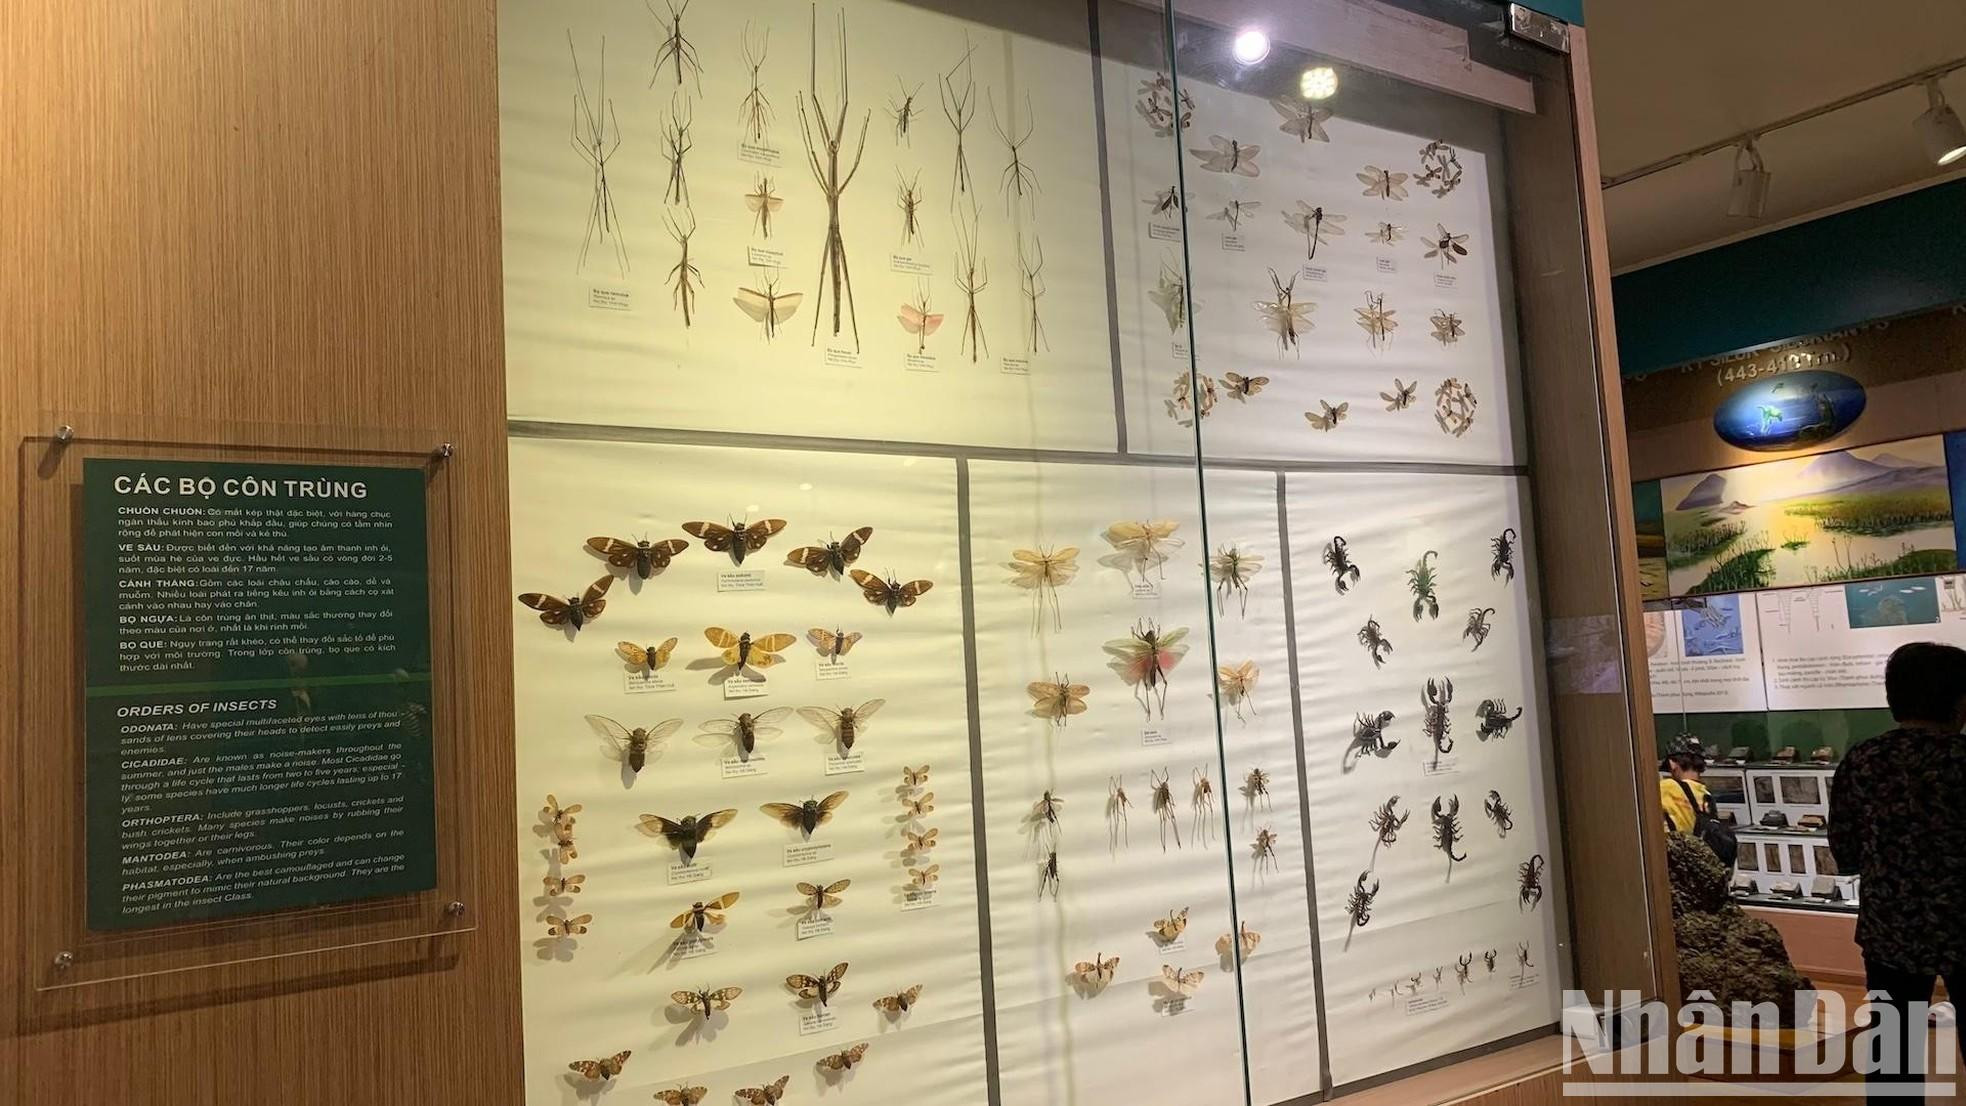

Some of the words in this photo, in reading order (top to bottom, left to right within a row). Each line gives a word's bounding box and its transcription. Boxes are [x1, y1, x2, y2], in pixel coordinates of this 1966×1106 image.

[114, 473, 171, 495] CÁC
[179, 476, 217, 499] BỘ
[222, 476, 277, 497] CÔN
[284, 477, 368, 498] TRÙNG
[118, 543, 133, 551] VE
[194, 601, 212, 609] hay
[139, 640, 167, 648] QUE:
[117, 704, 184, 717] ORDERS
[188, 703, 209, 713] OF
[213, 699, 276, 711] INSECTS
[120, 723, 177, 733] ODONATA:
[210, 719, 244, 729] special
[246, 716, 302, 725] multifaceted
[121, 736, 152, 744] sands
[154, 734, 164, 742] of
[190, 732, 232, 740] covering
[300, 725, 327, 733] detect
[329, 723, 355, 731] easily
[269, 748, 331, 758] noise-makers
[336, 744, 383, 753] throughout
[167, 768, 186, 776] and
[187, 767, 206, 776] just
[344, 754, 388, 763] Cicadidae
[390, 753, 401, 761] go
[120, 781, 160, 790] through
[189, 777, 214, 786] cycle
[216, 775, 235, 783] that
[135, 793, 162, 801] some
[165, 790, 203, 799] species
[205, 787, 229, 795] have
[231, 784, 257, 792] much
[290, 780, 304, 788] life
[306, 778, 335, 787] cycles
[336, 776, 365, 784] lasting
[380, 773, 389, 781] to
[122, 814, 203, 827] ORTHOPTERA:
[207, 810, 242, 819] Include
[351, 798, 385, 806] crickets
[387, 795, 403, 803] and
[122, 830, 147, 838] bush
[198, 823, 224, 831] Many
[229, 819, 265, 829] species
[269, 816, 295, 824] make
[122, 841, 151, 849] wings
[154, 837, 195, 847] together
[122, 851, 190, 863] MANTODEA:
[281, 840, 303, 848] Their
[307, 837, 329, 845] color
[333, 833, 371, 842] depends
[216, 857, 243, 865] when
[245, 851, 296, 862] ambushing
[122, 875, 212, 890] PHASMATODEA:
[252, 868, 272, 876] best
[274, 861, 333, 873] camouflaged
[335, 859, 352, 867] and
[372, 854, 404, 863] change
[122, 894, 145, 902] their
[147, 889, 188, 900] pigment
[202, 884, 231, 892] mimic
[234, 881, 255, 889] their
[257, 876, 290, 886] natural
[122, 903, 160, 913] longest
[174, 900, 190, 908] the
[192, 895, 221, 904] insect
